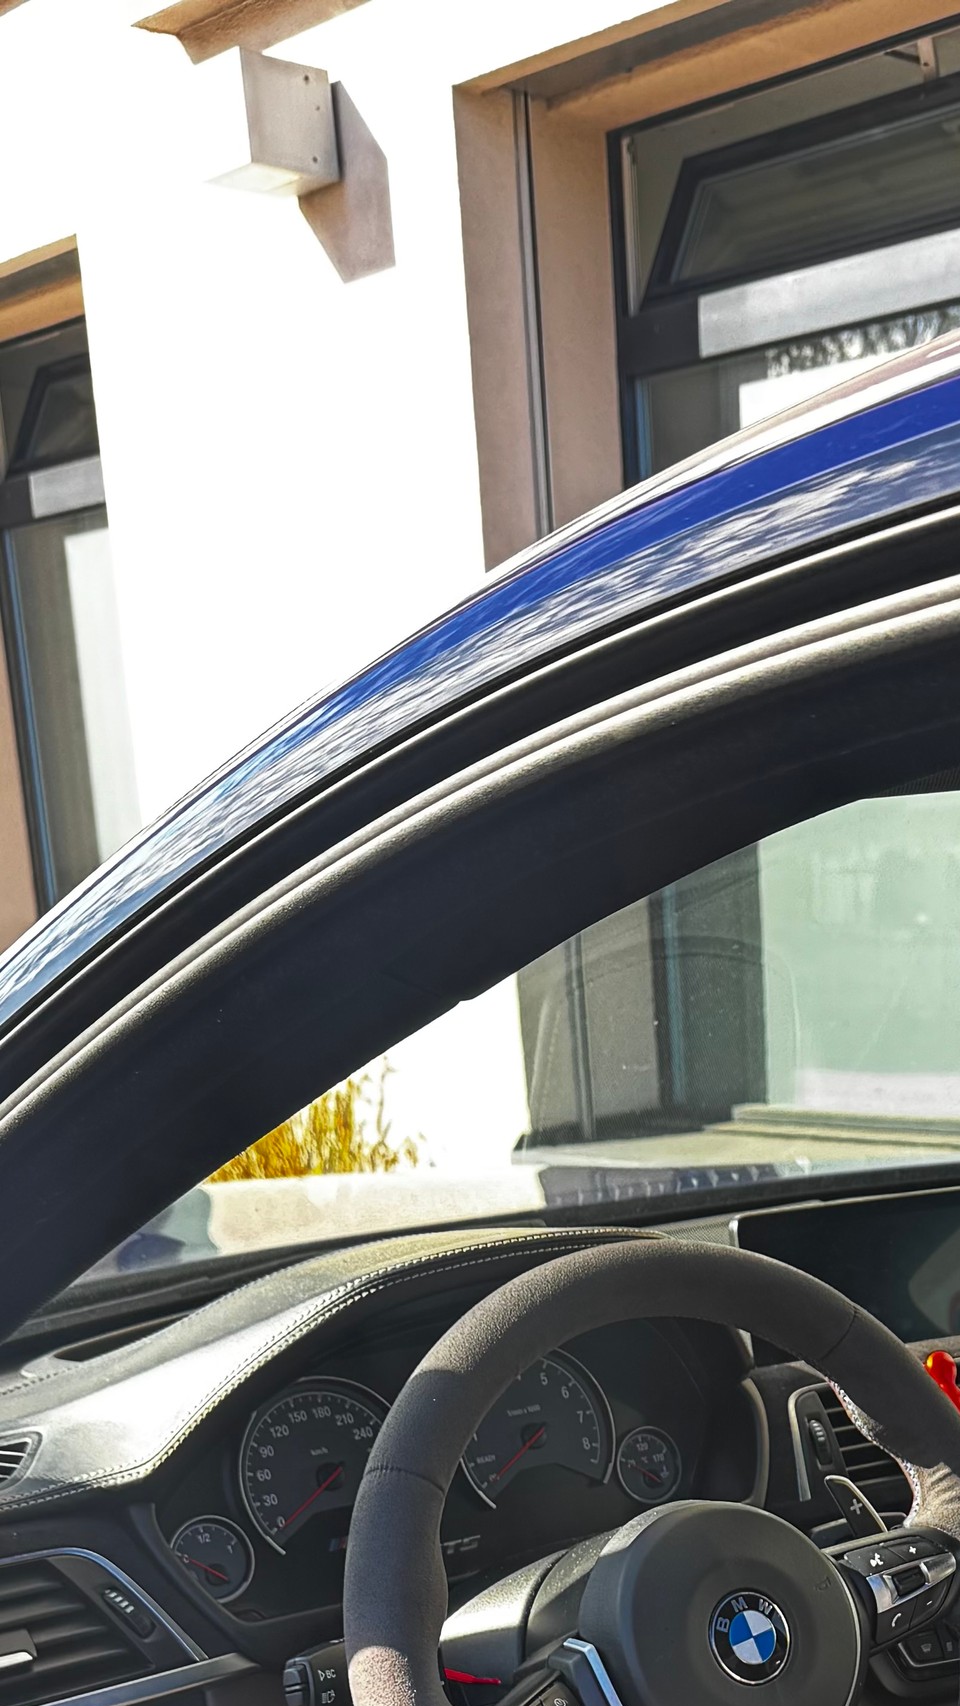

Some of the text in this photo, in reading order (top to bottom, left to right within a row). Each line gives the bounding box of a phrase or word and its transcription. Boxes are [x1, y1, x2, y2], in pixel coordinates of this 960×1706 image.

[540, 1372, 548, 1386] 5
[561, 1386, 569, 1399] 6
[288, 1410, 307, 1424] 150
[312, 1406, 331, 1419] 180
[576, 1410, 584, 1424] 7
[335, 1413, 354, 1426] 210
[270, 1424, 289, 1438] 120
[353, 1427, 373, 1440] 240
[582, 1437, 591, 1450] 8
[259, 1445, 274, 1458] 90
[476, 1455, 496, 1464] READY
[257, 1468, 271, 1481] 60
[263, 1493, 278, 1506] 30
[277, 1516, 286, 1528] 0
[196, 1532, 211, 1544] 1/2
[716, 1596, 773, 1633] BMW
[325, 1668, 337, 1679] BC
